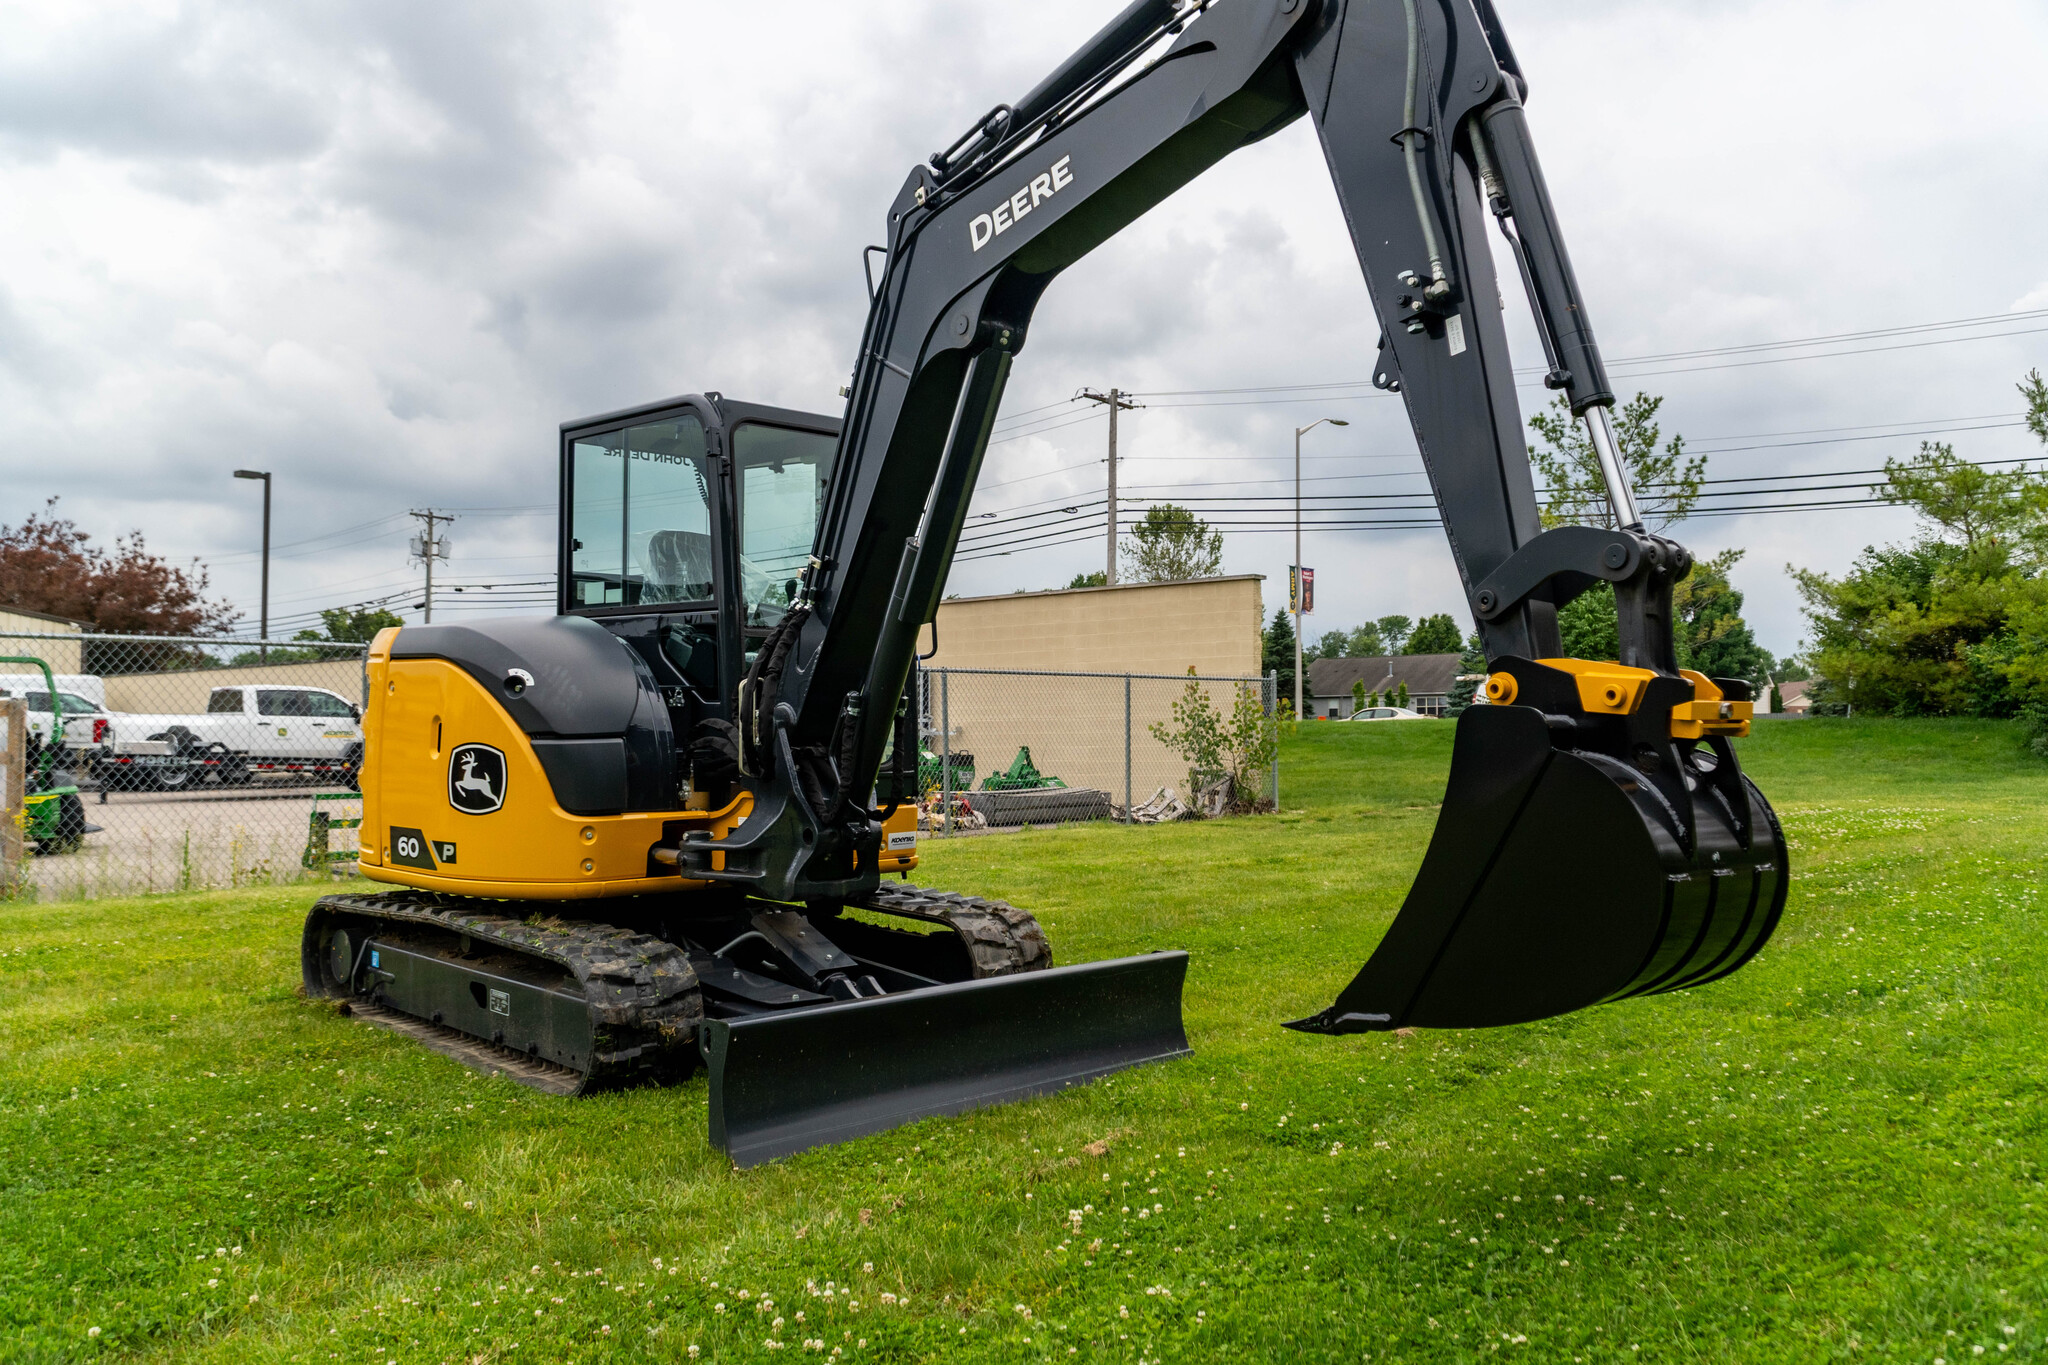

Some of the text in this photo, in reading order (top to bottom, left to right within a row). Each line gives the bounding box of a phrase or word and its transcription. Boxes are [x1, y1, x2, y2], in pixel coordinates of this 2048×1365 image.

[969, 154, 1074, 253] DEERE
[398, 836, 454, 861] 60 P
